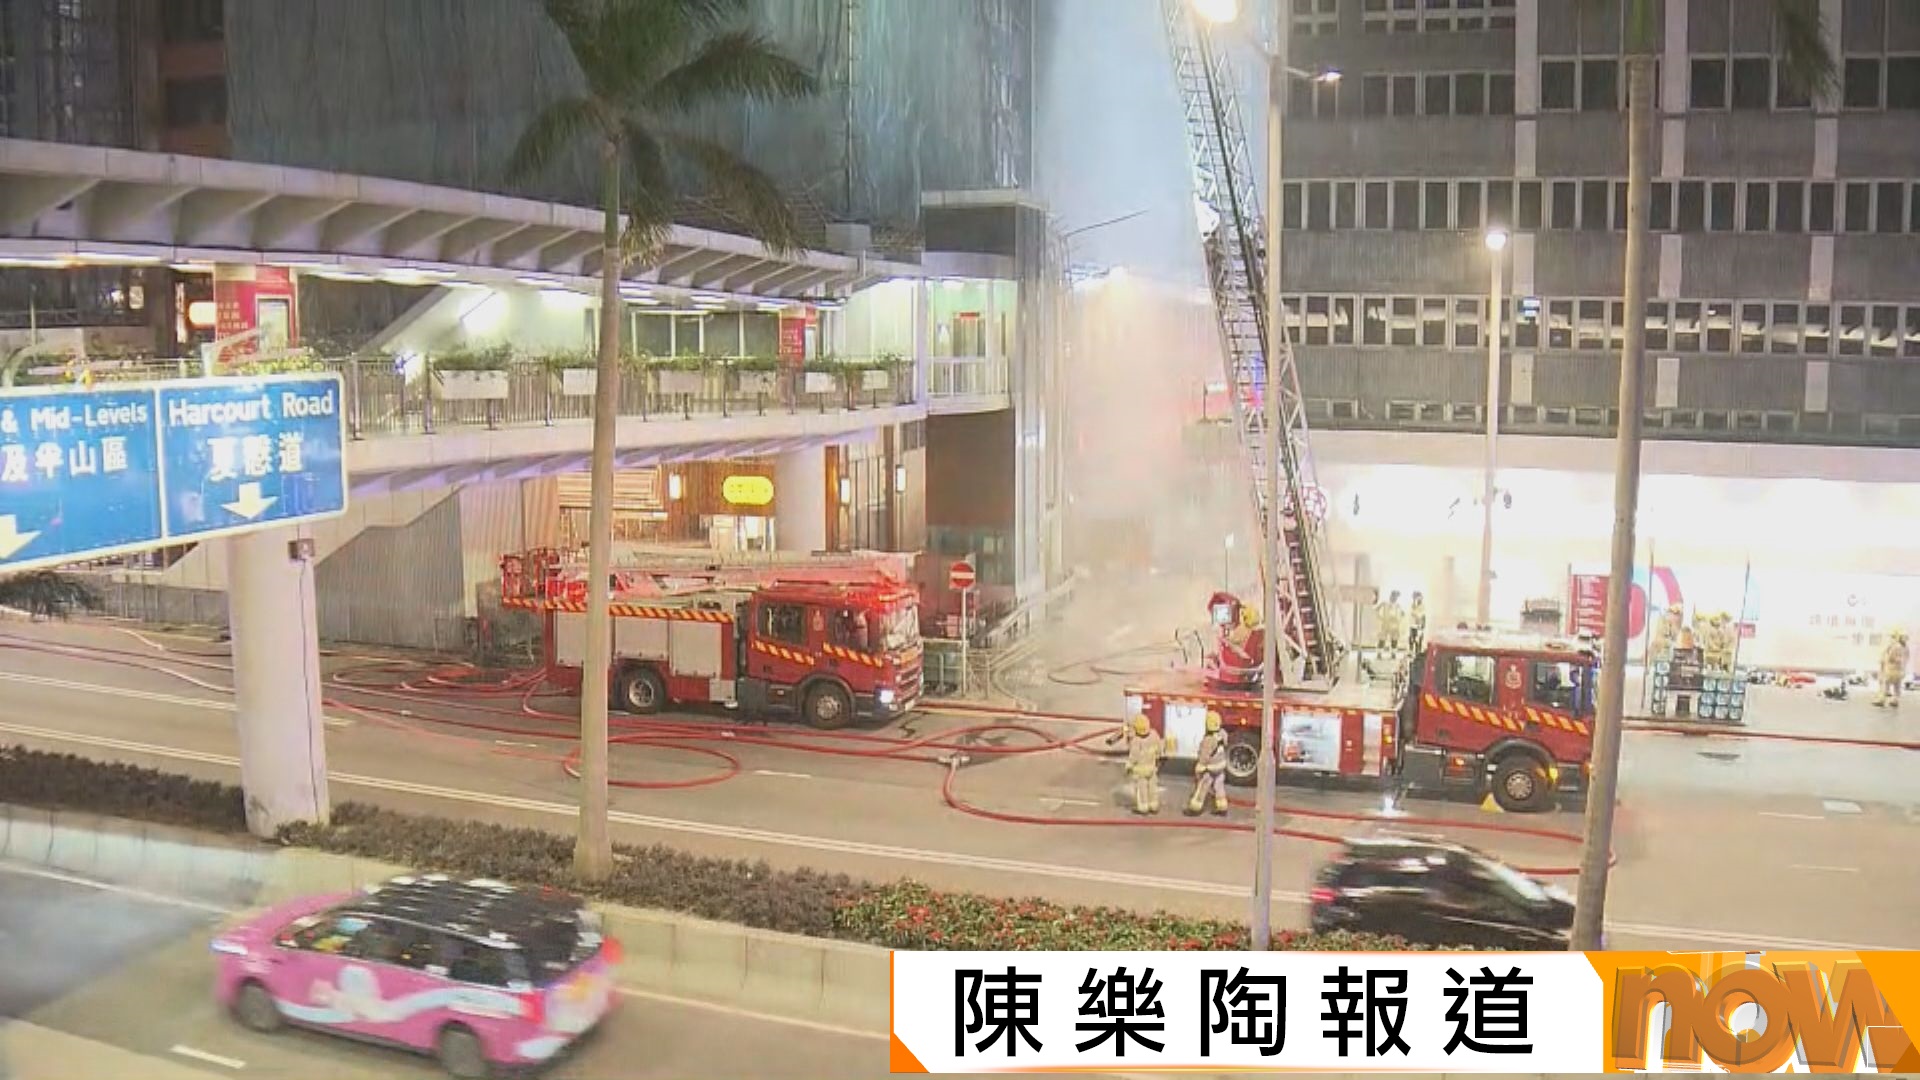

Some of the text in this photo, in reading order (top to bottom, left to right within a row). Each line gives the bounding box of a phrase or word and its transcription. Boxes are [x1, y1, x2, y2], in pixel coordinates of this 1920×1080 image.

[1, 402, 147, 433] & Mid-Levels
[168, 390, 334, 426] Harcourt Road
